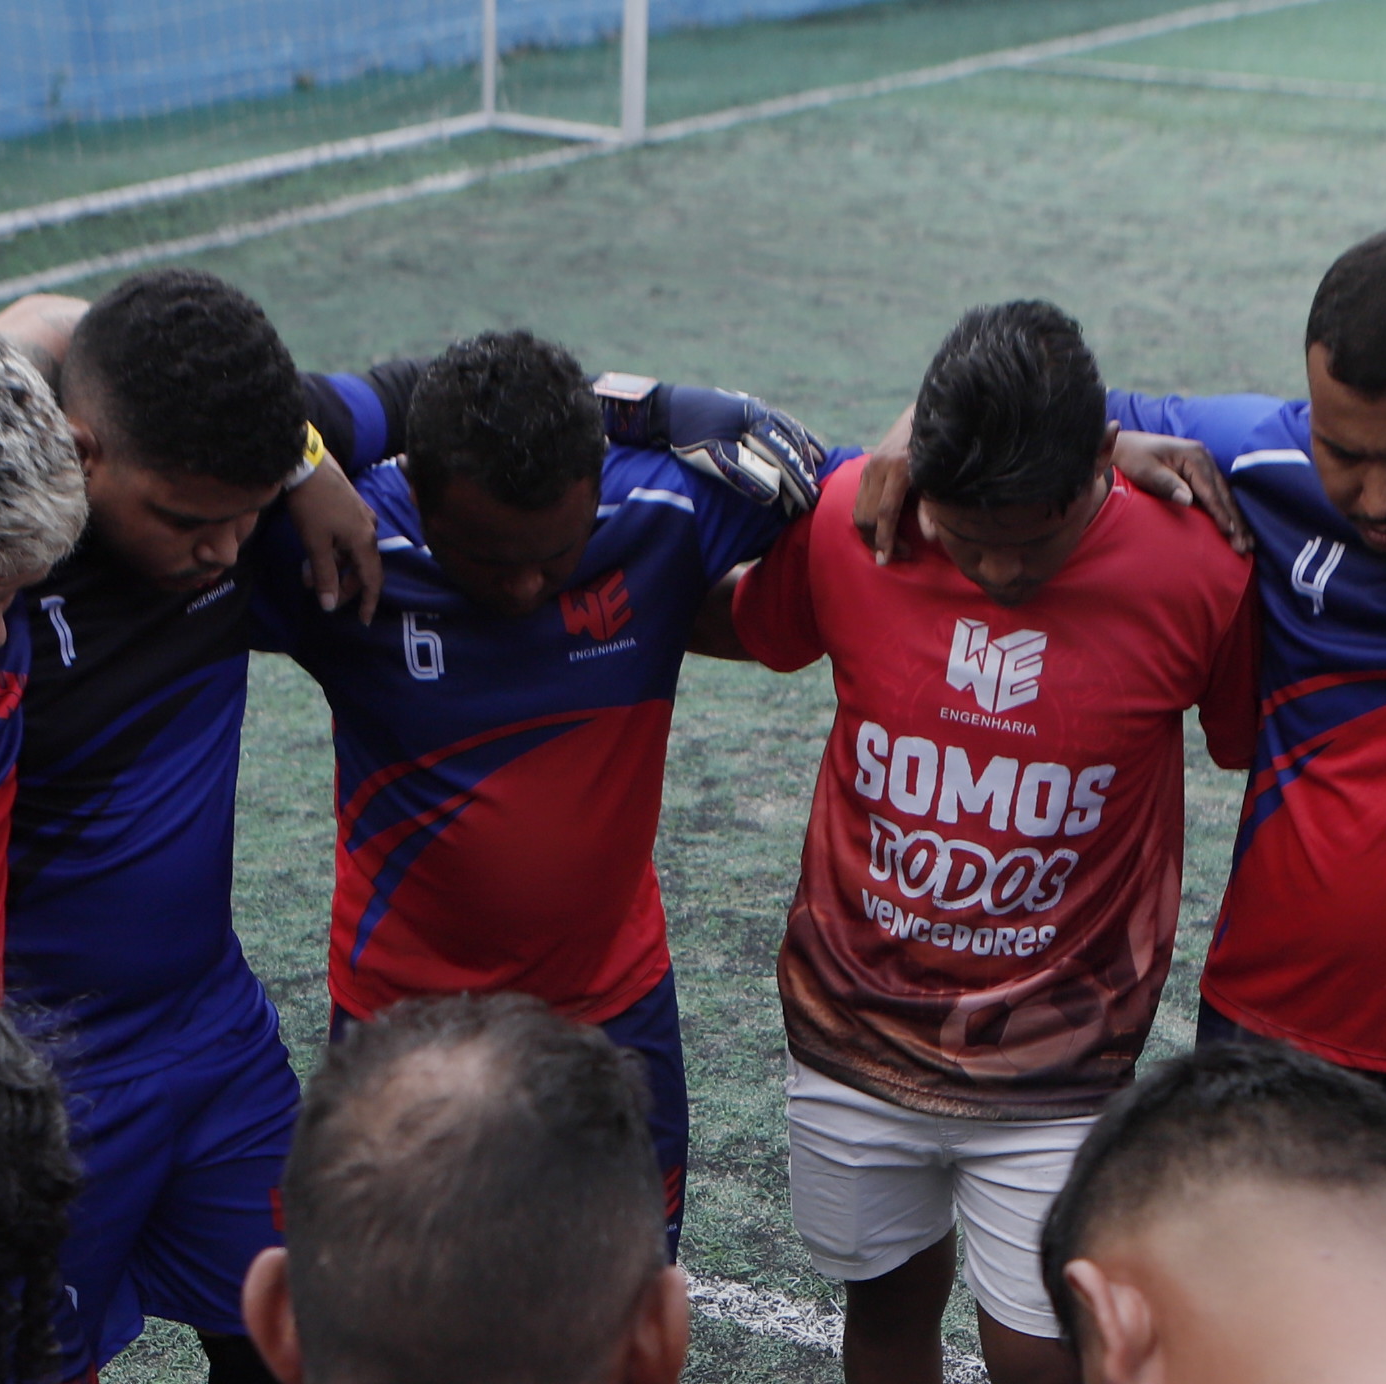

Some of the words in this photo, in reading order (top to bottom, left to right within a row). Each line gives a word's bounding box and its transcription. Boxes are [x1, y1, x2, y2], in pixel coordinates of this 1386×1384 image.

[558, 568, 633, 641] WE
[1291, 535, 1346, 615] 4
[40, 594, 77, 667] 1
[402, 611, 446, 680] 6
[569, 637, 637, 662] ENGENHARIA
[946, 617, 1048, 714] WE
[940, 706, 1037, 737] ENGENHARIA
[854, 720, 1116, 837] SOMOS
[868, 812, 1080, 915] TODOS
